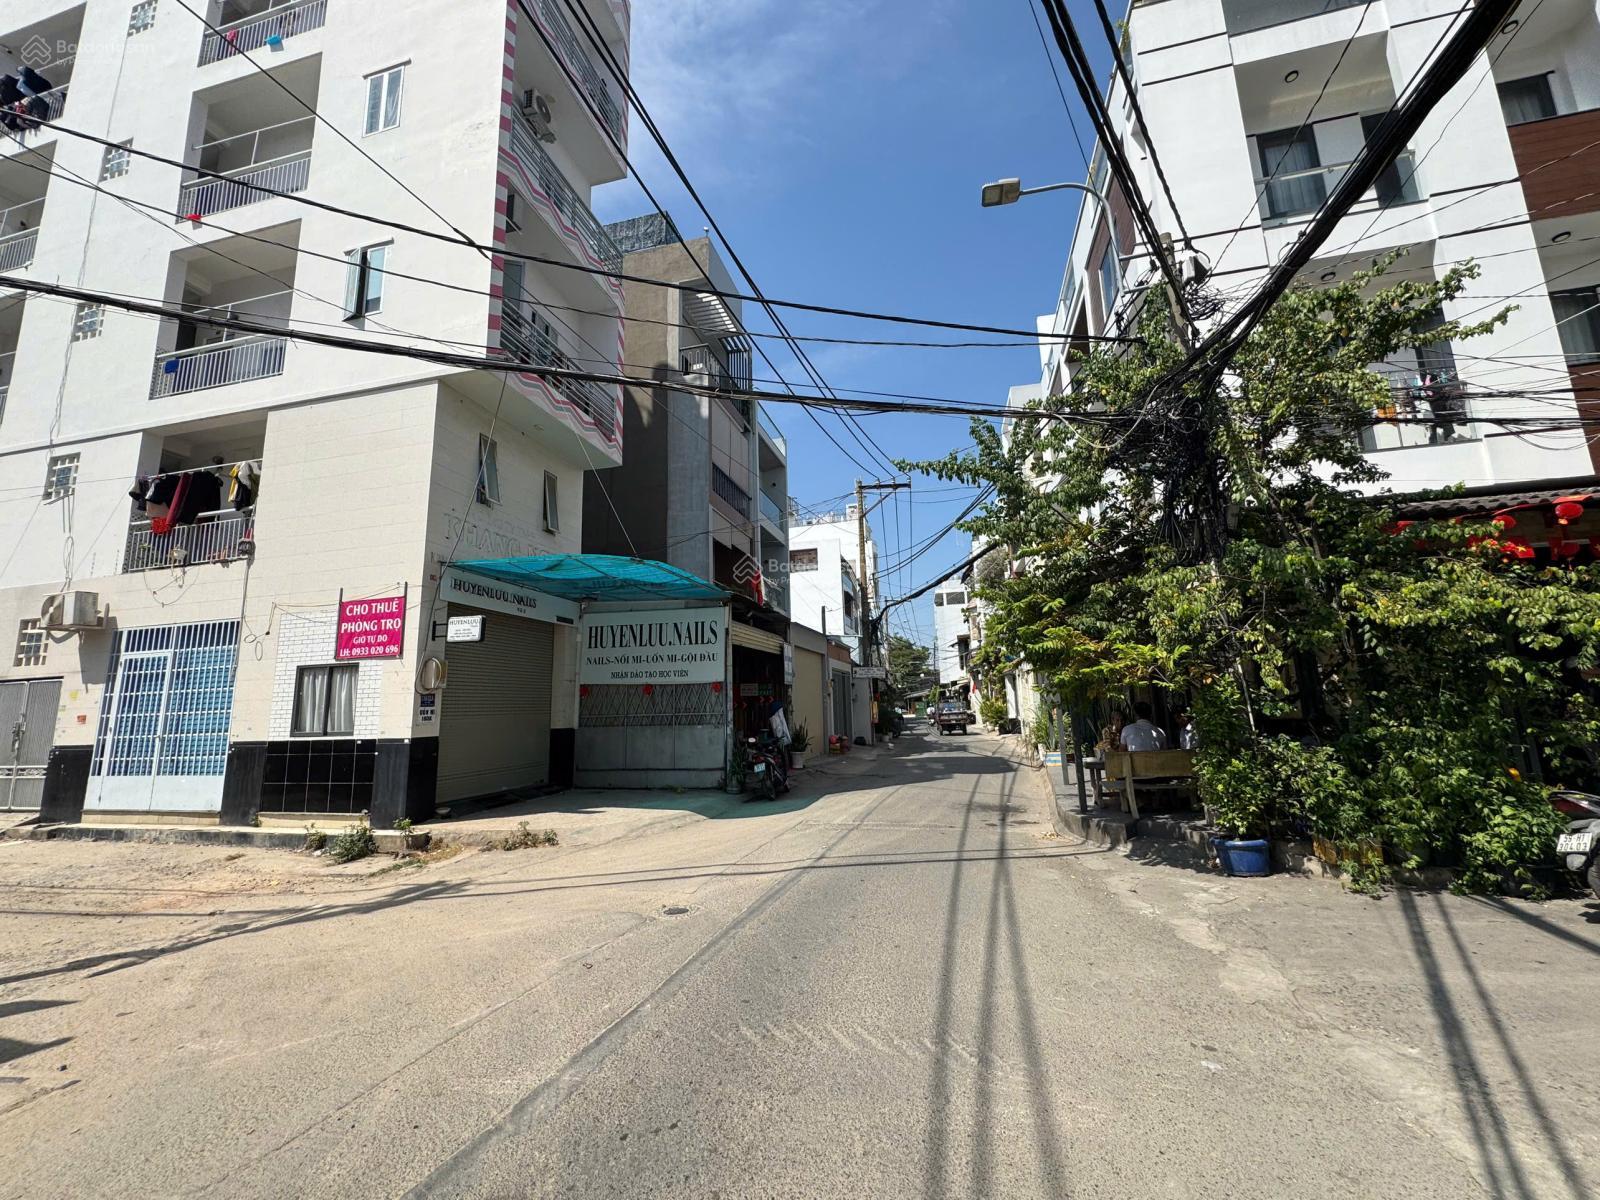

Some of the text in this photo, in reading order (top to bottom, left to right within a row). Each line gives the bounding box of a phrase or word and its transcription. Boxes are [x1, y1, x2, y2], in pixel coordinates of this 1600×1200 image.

[346, 598, 400, 617] CHO THUÊ
[341, 617, 401, 634] PHÒNG TRỌ
[587, 619, 718, 649] HUYENLUU.NAILS
[351, 646, 369, 656] 0933
[370, 645, 384, 655] 020
[385, 644, 399, 654] 696
